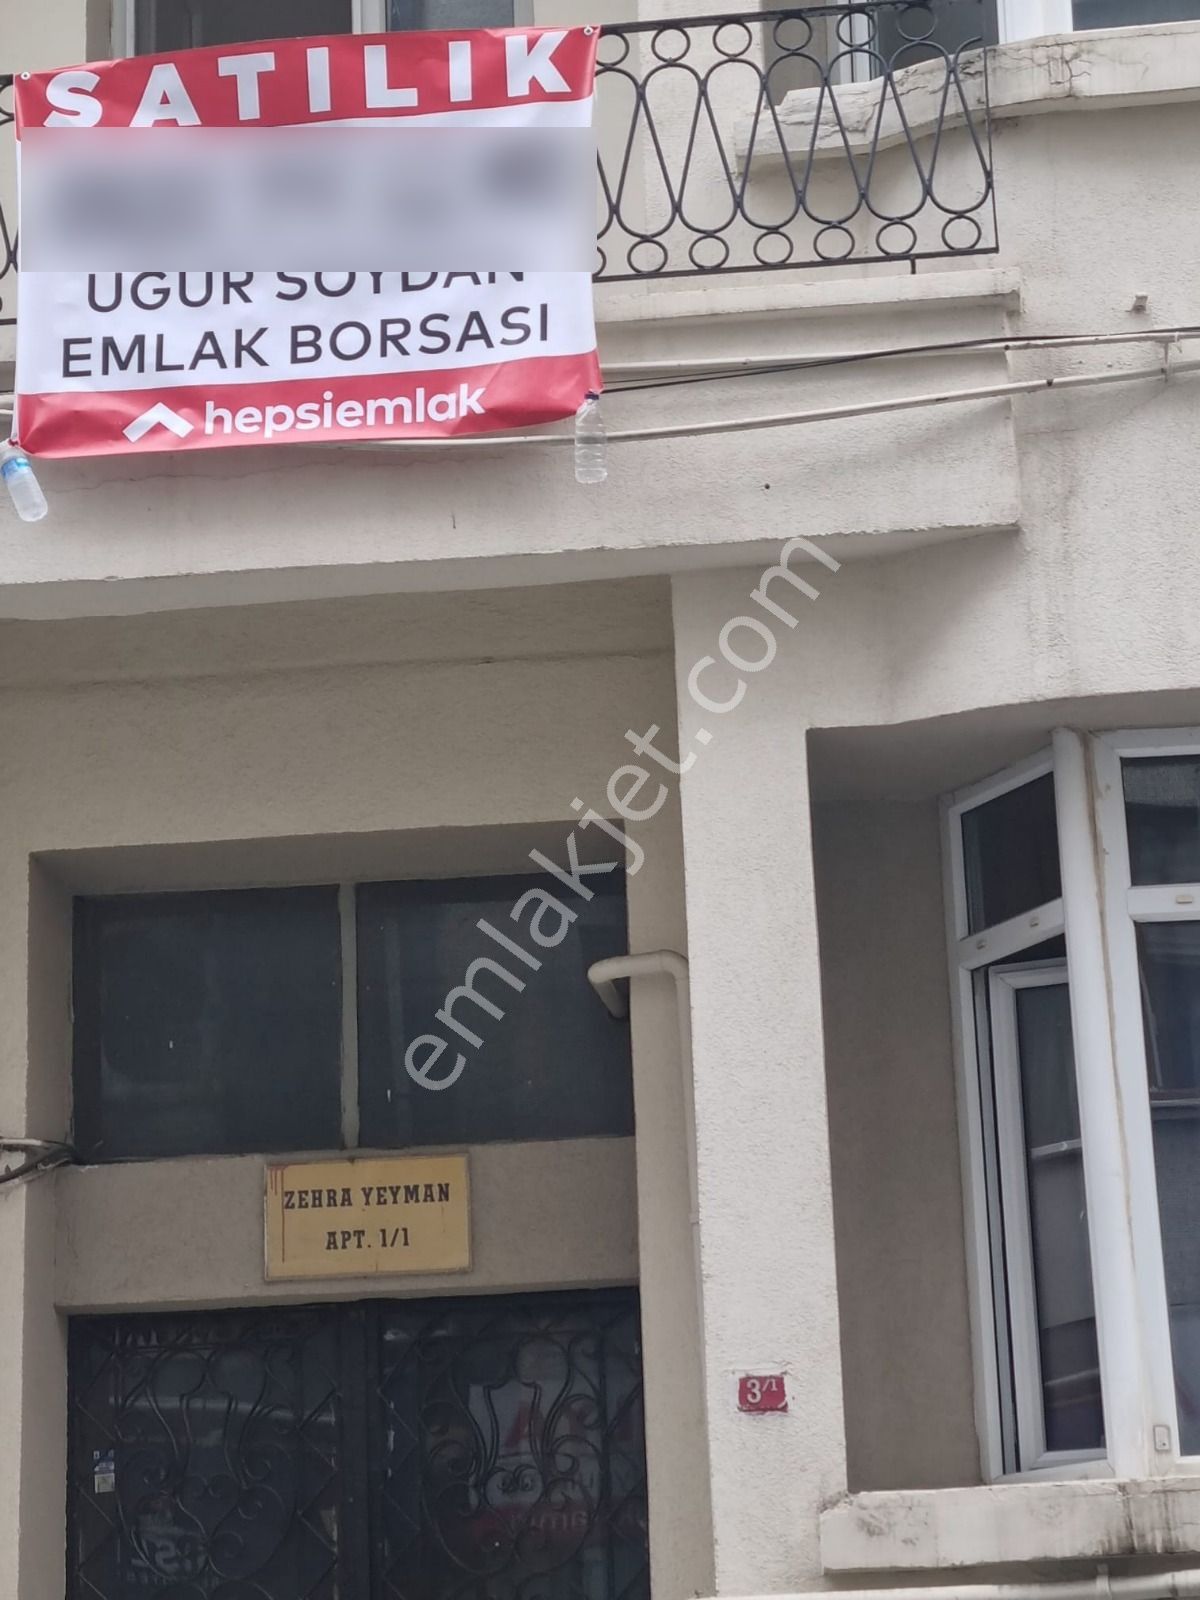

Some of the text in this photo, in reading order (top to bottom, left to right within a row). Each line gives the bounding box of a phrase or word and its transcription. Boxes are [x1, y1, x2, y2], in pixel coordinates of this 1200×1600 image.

[43, 31, 572, 127] SATILIK
[62, 303, 549, 377] EMLAK BORSASI
[204, 383, 486, 438] hepsiemlak
[284, 1183, 450, 1209] ZEHRA YEYMAN
[325, 1227, 410, 1250] APT. 1/1
